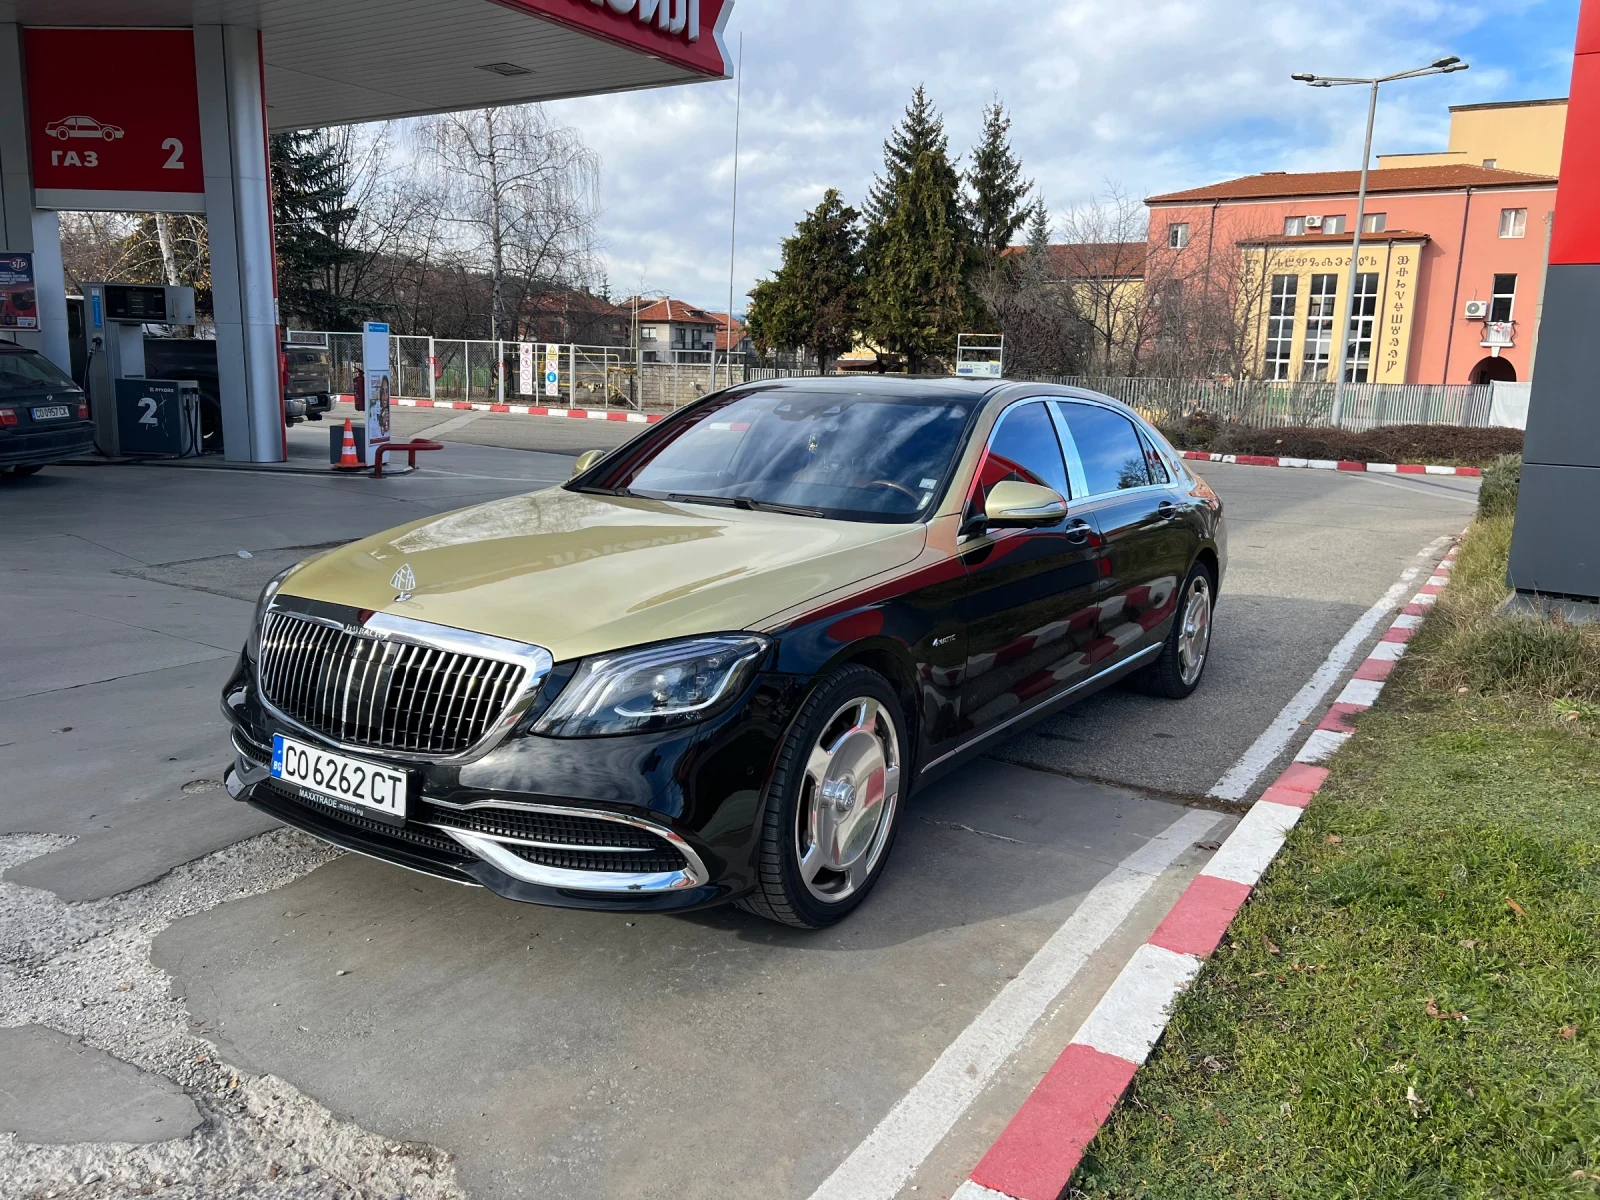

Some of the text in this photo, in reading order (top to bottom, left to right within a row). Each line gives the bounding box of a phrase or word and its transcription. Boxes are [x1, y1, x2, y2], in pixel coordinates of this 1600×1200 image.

[51, 150, 99, 167] ГАЗ
[161, 137, 185, 170] 2
[12, 258, 26, 269] STP
[138, 397, 158, 424] 2
[273, 760, 282, 771] BG
[299, 789, 338, 808] MAXXTRADE
